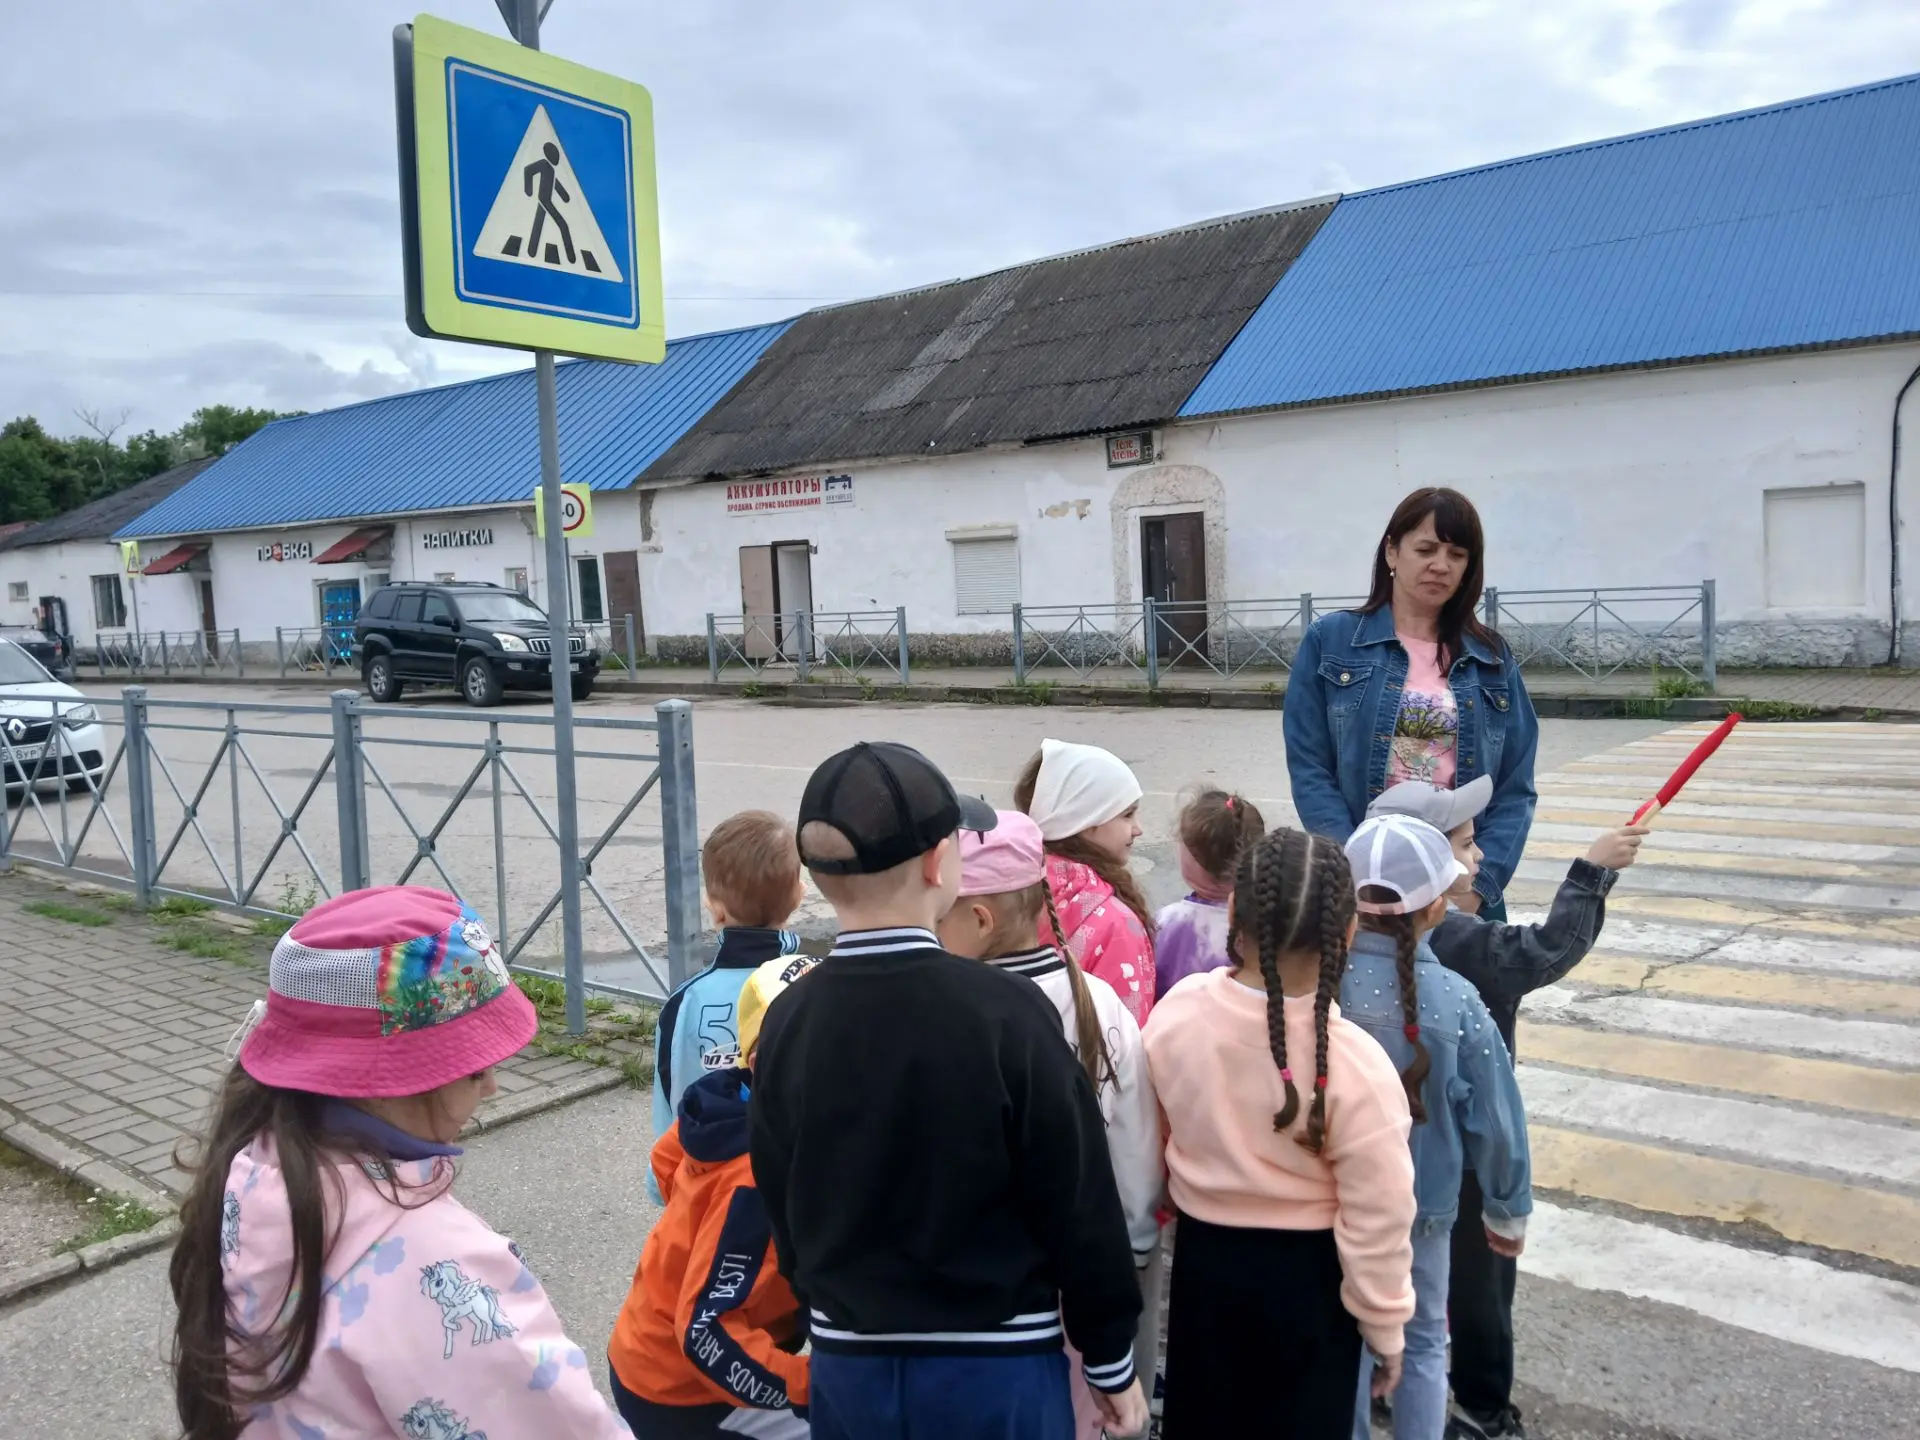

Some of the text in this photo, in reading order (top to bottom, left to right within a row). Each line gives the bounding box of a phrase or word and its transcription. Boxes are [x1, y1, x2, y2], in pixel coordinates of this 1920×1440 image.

[562, 503, 575, 518] 0
[423, 528, 493, 549] НАПИТКИ
[698, 1003, 737, 1058] 5
[709, 1253, 752, 1299] BEST!
[725, 1360, 788, 1409] RIENDS
